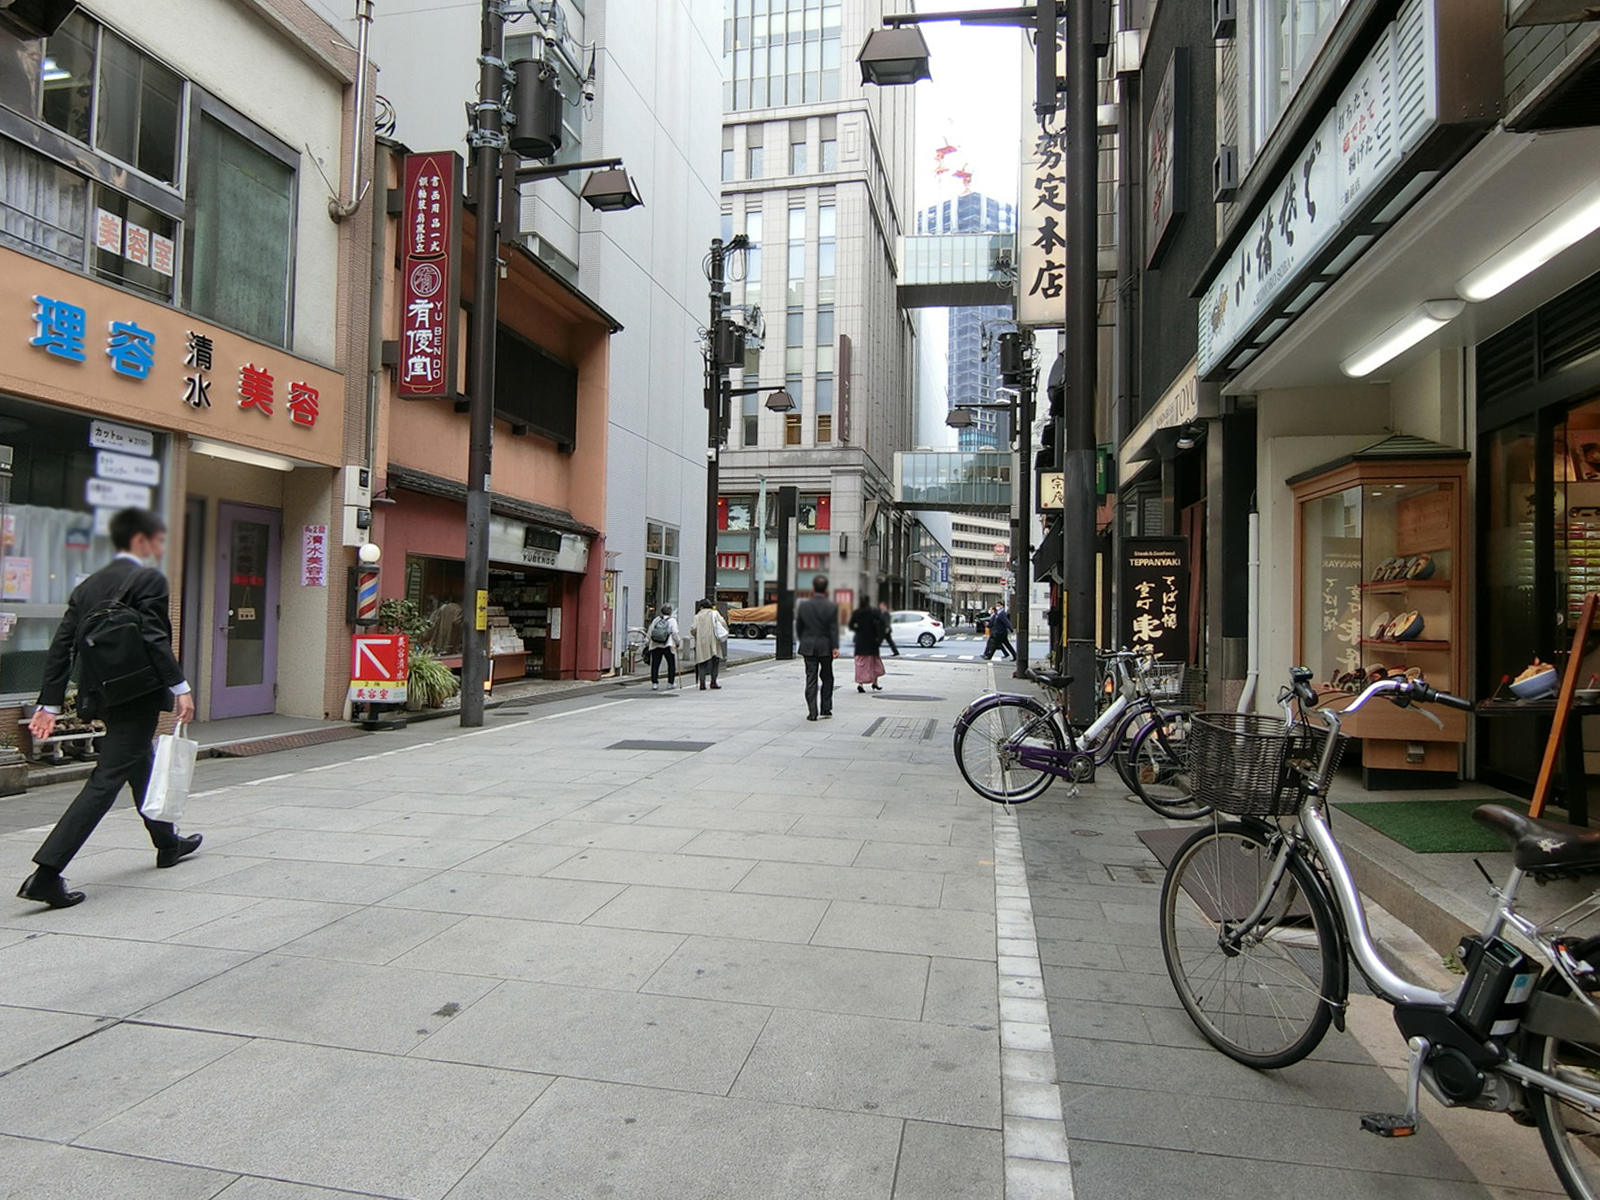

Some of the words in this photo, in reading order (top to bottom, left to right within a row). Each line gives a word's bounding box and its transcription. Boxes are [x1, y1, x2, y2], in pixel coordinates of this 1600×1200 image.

[99, 214, 172, 275] 美容室
[29, 294, 156, 380] 理容
[182, 330, 214, 408] 清水
[237, 362, 320, 427] 美容
[1175, 375, 1198, 422] TOYO
[306, 535, 323, 587] 清水美容室
[1129, 559, 1181, 567] TEPPANYAKI
[396, 636, 406, 680] 美容清水
[356, 688, 390, 699] 美容室
